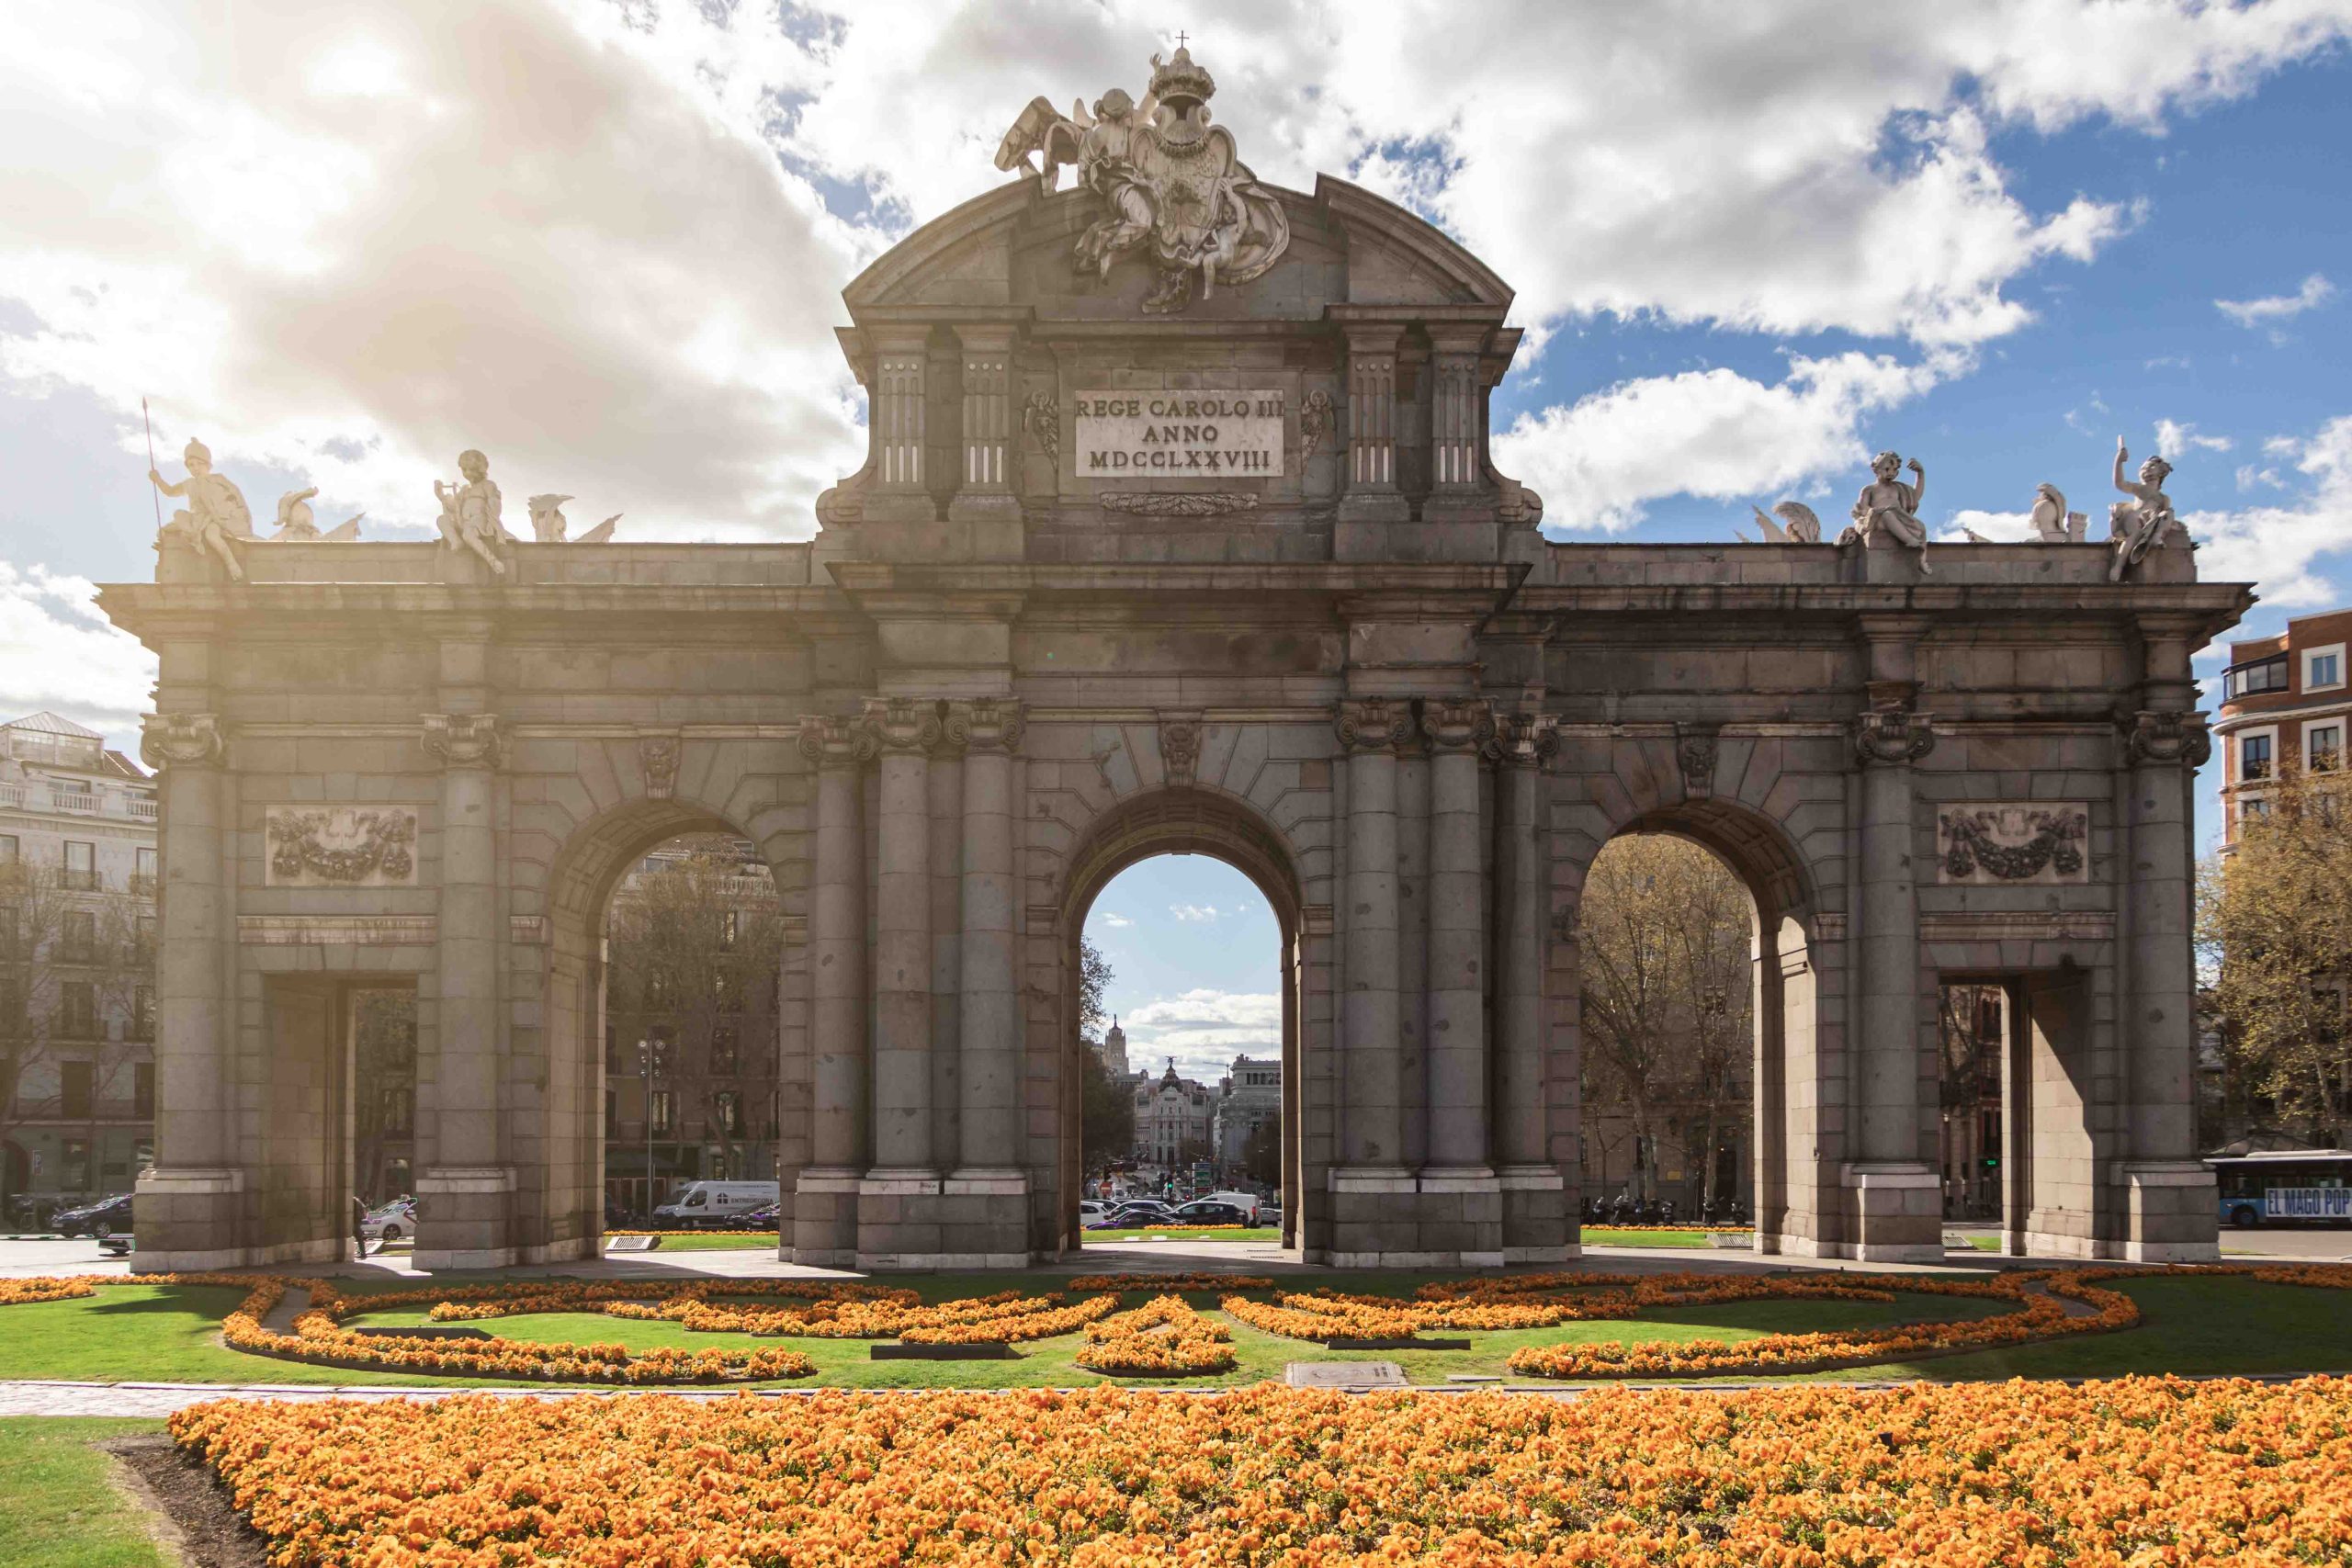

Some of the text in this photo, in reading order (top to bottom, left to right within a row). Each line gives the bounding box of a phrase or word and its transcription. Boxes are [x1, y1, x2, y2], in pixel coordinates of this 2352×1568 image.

[1076, 400, 1285, 418] REGE CAROLO III
[1142, 425, 1218, 443] ANNO
[1089, 450, 1271, 468] MDCCLXXVIII
[2267, 1189, 2350, 1214] EL MAGO POP
